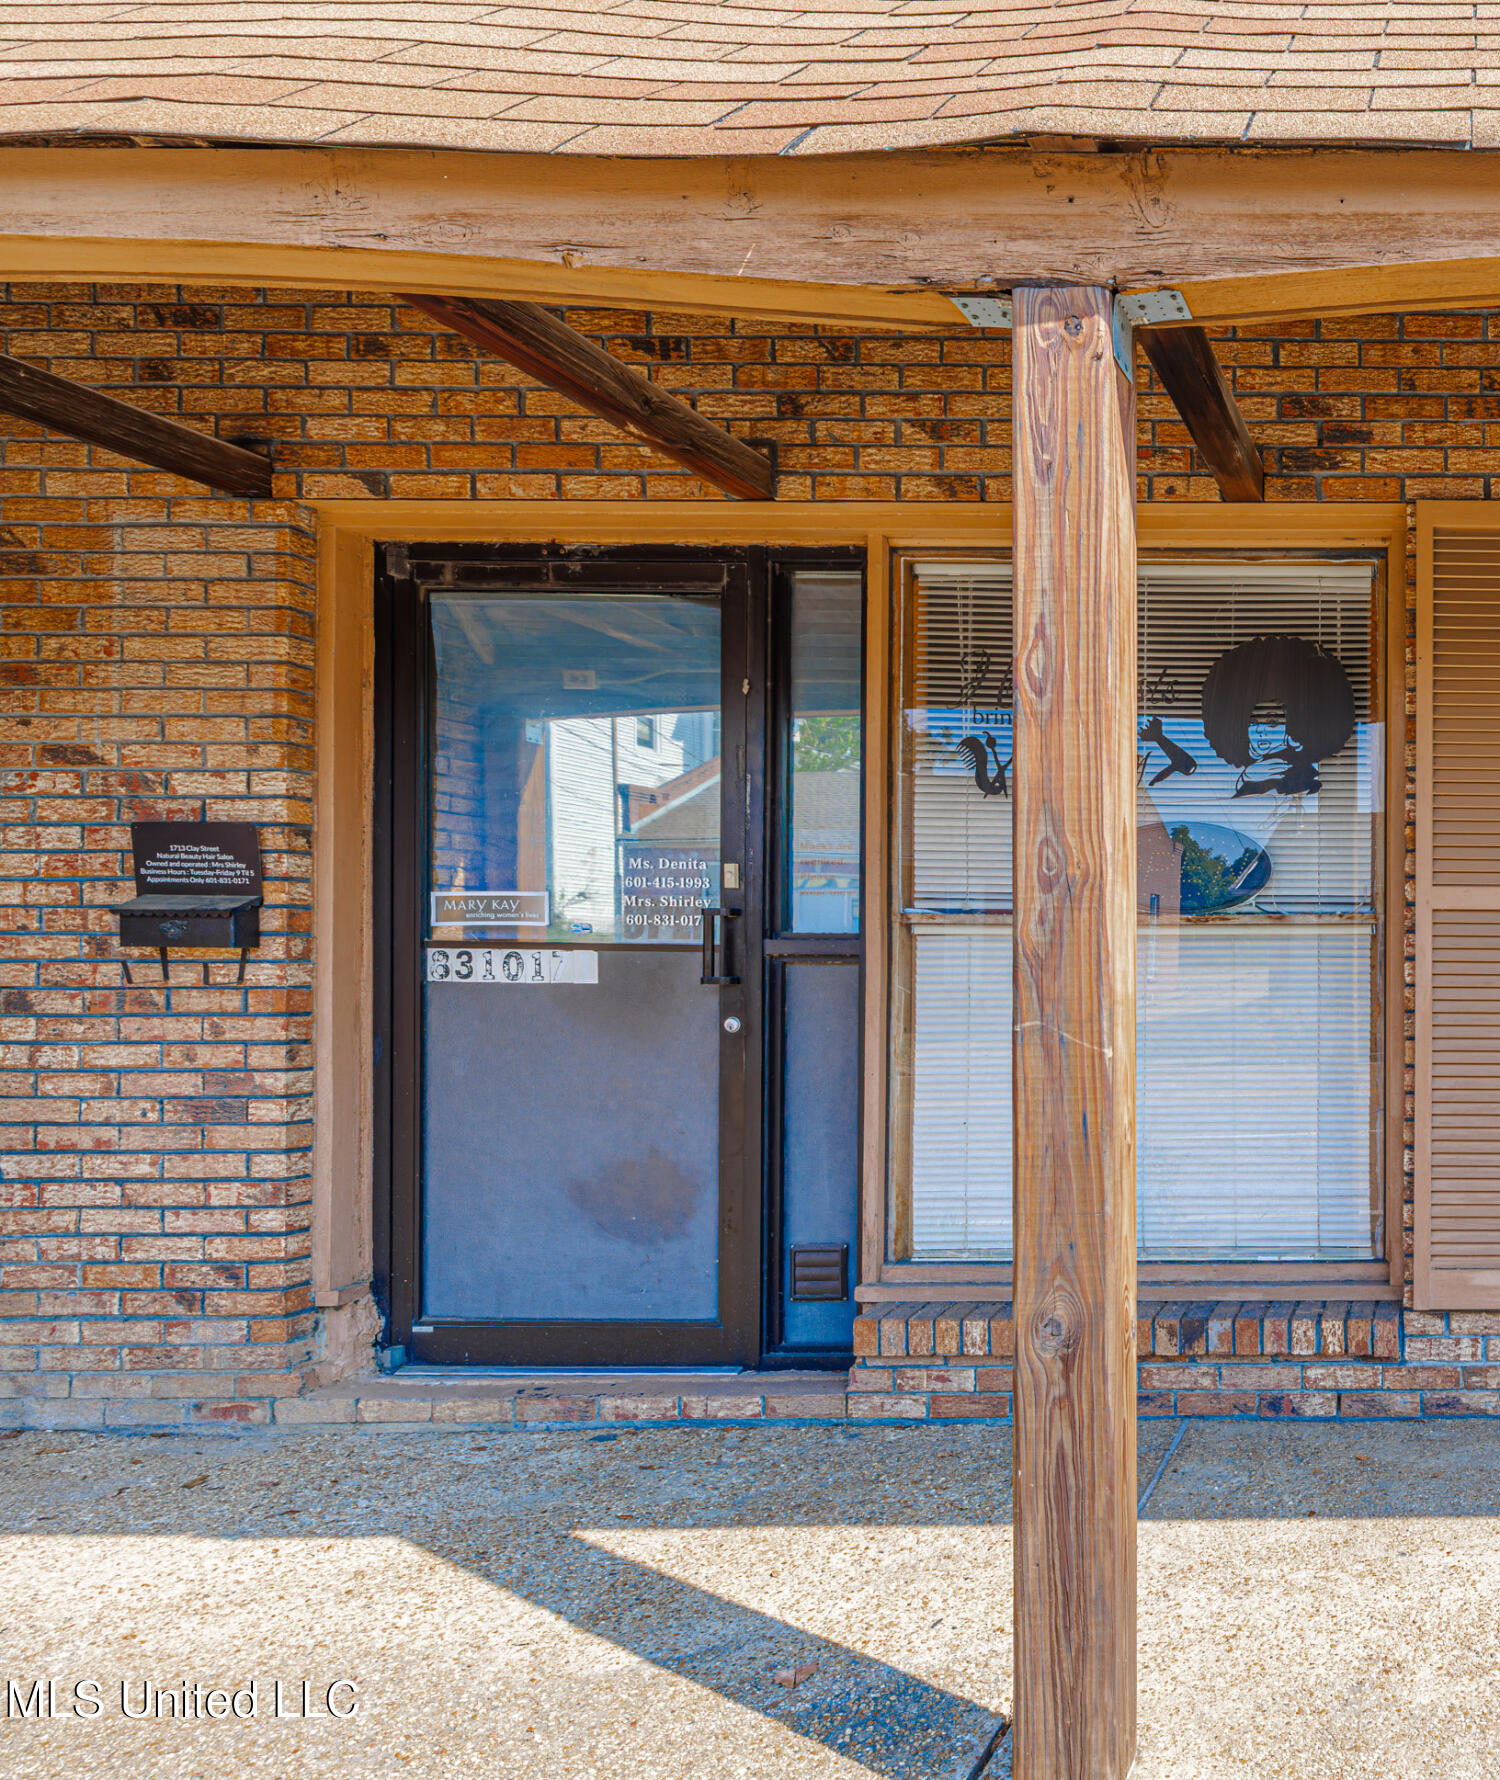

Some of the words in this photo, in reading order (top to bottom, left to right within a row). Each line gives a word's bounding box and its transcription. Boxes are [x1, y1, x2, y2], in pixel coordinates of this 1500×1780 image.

[973, 705, 1012, 725] brin
[629, 858, 654, 869] Ms.
[659, 858, 707, 870] Denita
[625, 877, 710, 888] 601-415-1993
[444, 900, 487, 912] MARY
[492, 900, 520, 912] KAY
[624, 896, 655, 907] Mrs.
[660, 896, 712, 908] Shirley
[626, 914, 702, 926] 601-831-017
